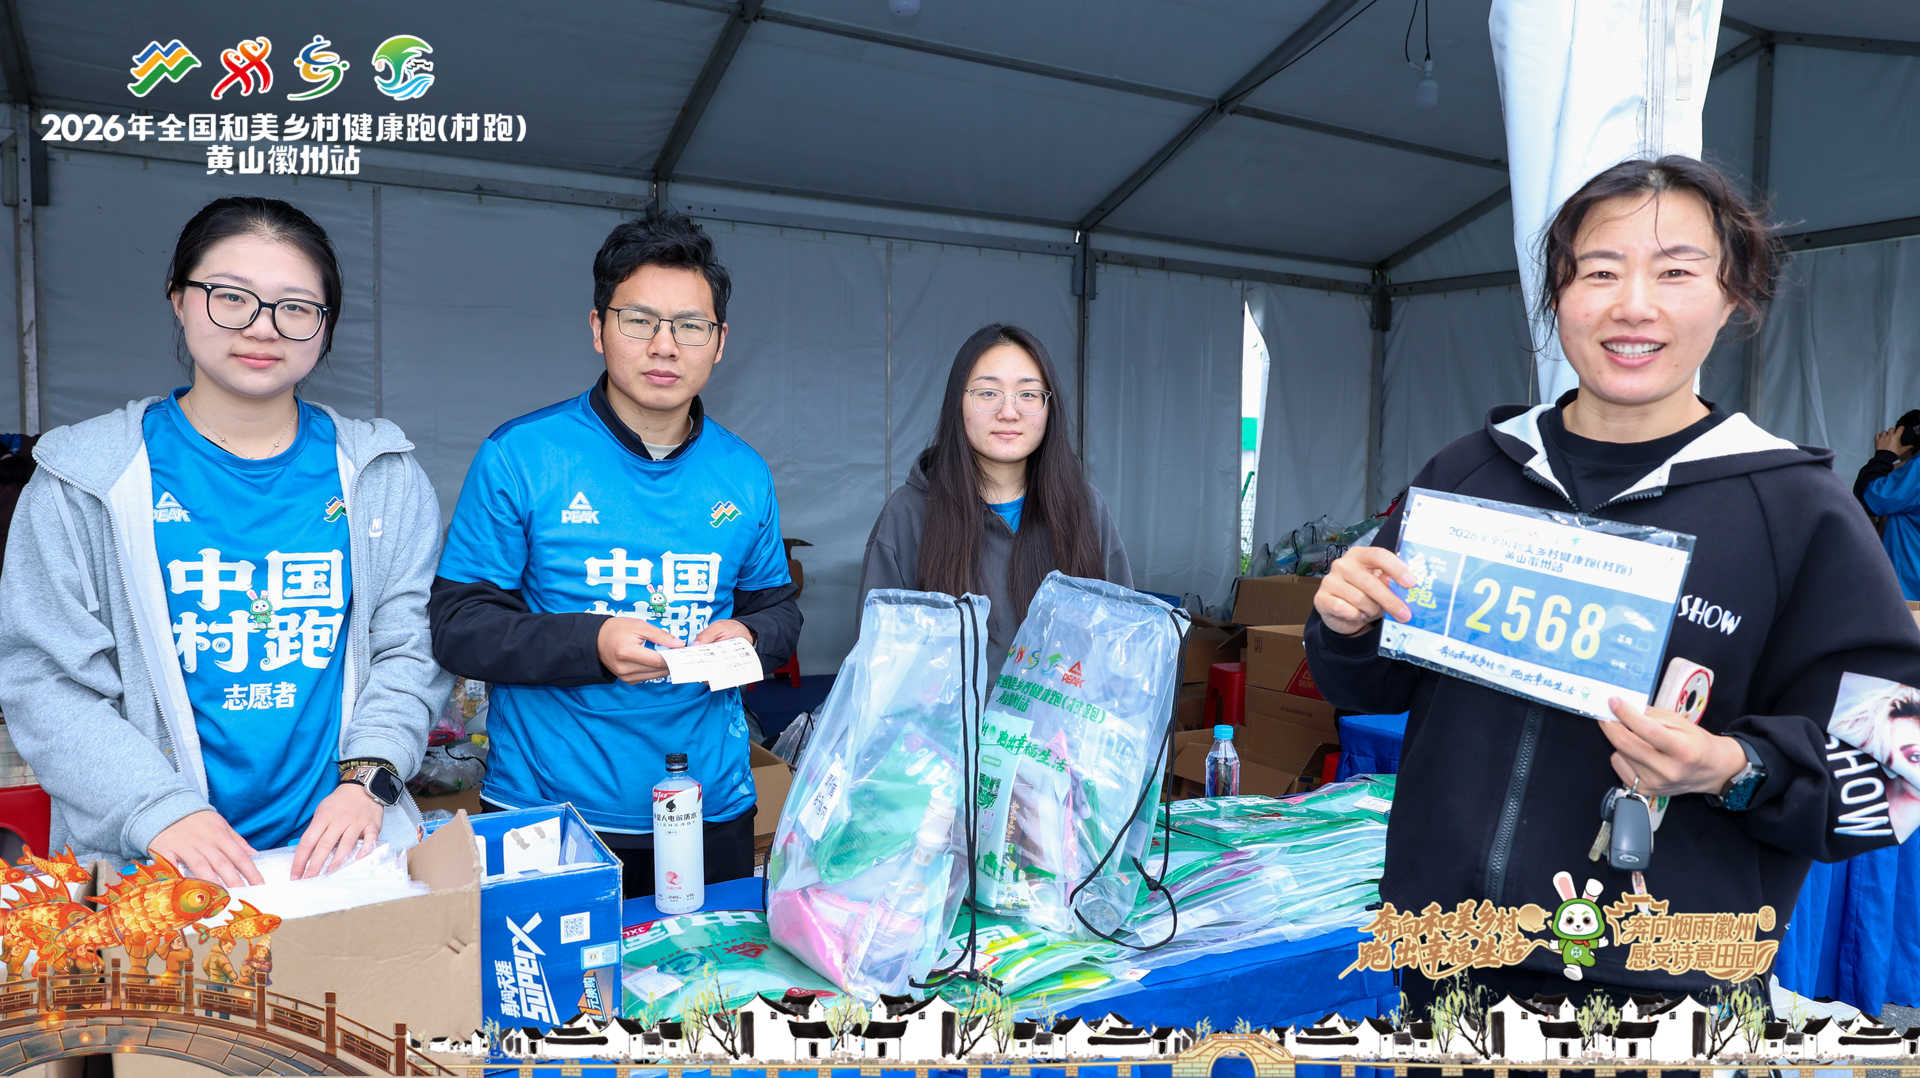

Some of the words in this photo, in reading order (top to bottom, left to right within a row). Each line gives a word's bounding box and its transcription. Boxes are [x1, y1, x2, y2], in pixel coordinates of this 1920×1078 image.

[561, 510, 600, 524] PEAK
[166, 548, 344, 610] 中国
[583, 547, 723, 603] 中国
[170, 609, 344, 673] 村跑
[1465, 577, 1607, 660] 2568
[1678, 594, 1743, 636] SHOW
[222, 682, 297, 711] 志愿者
